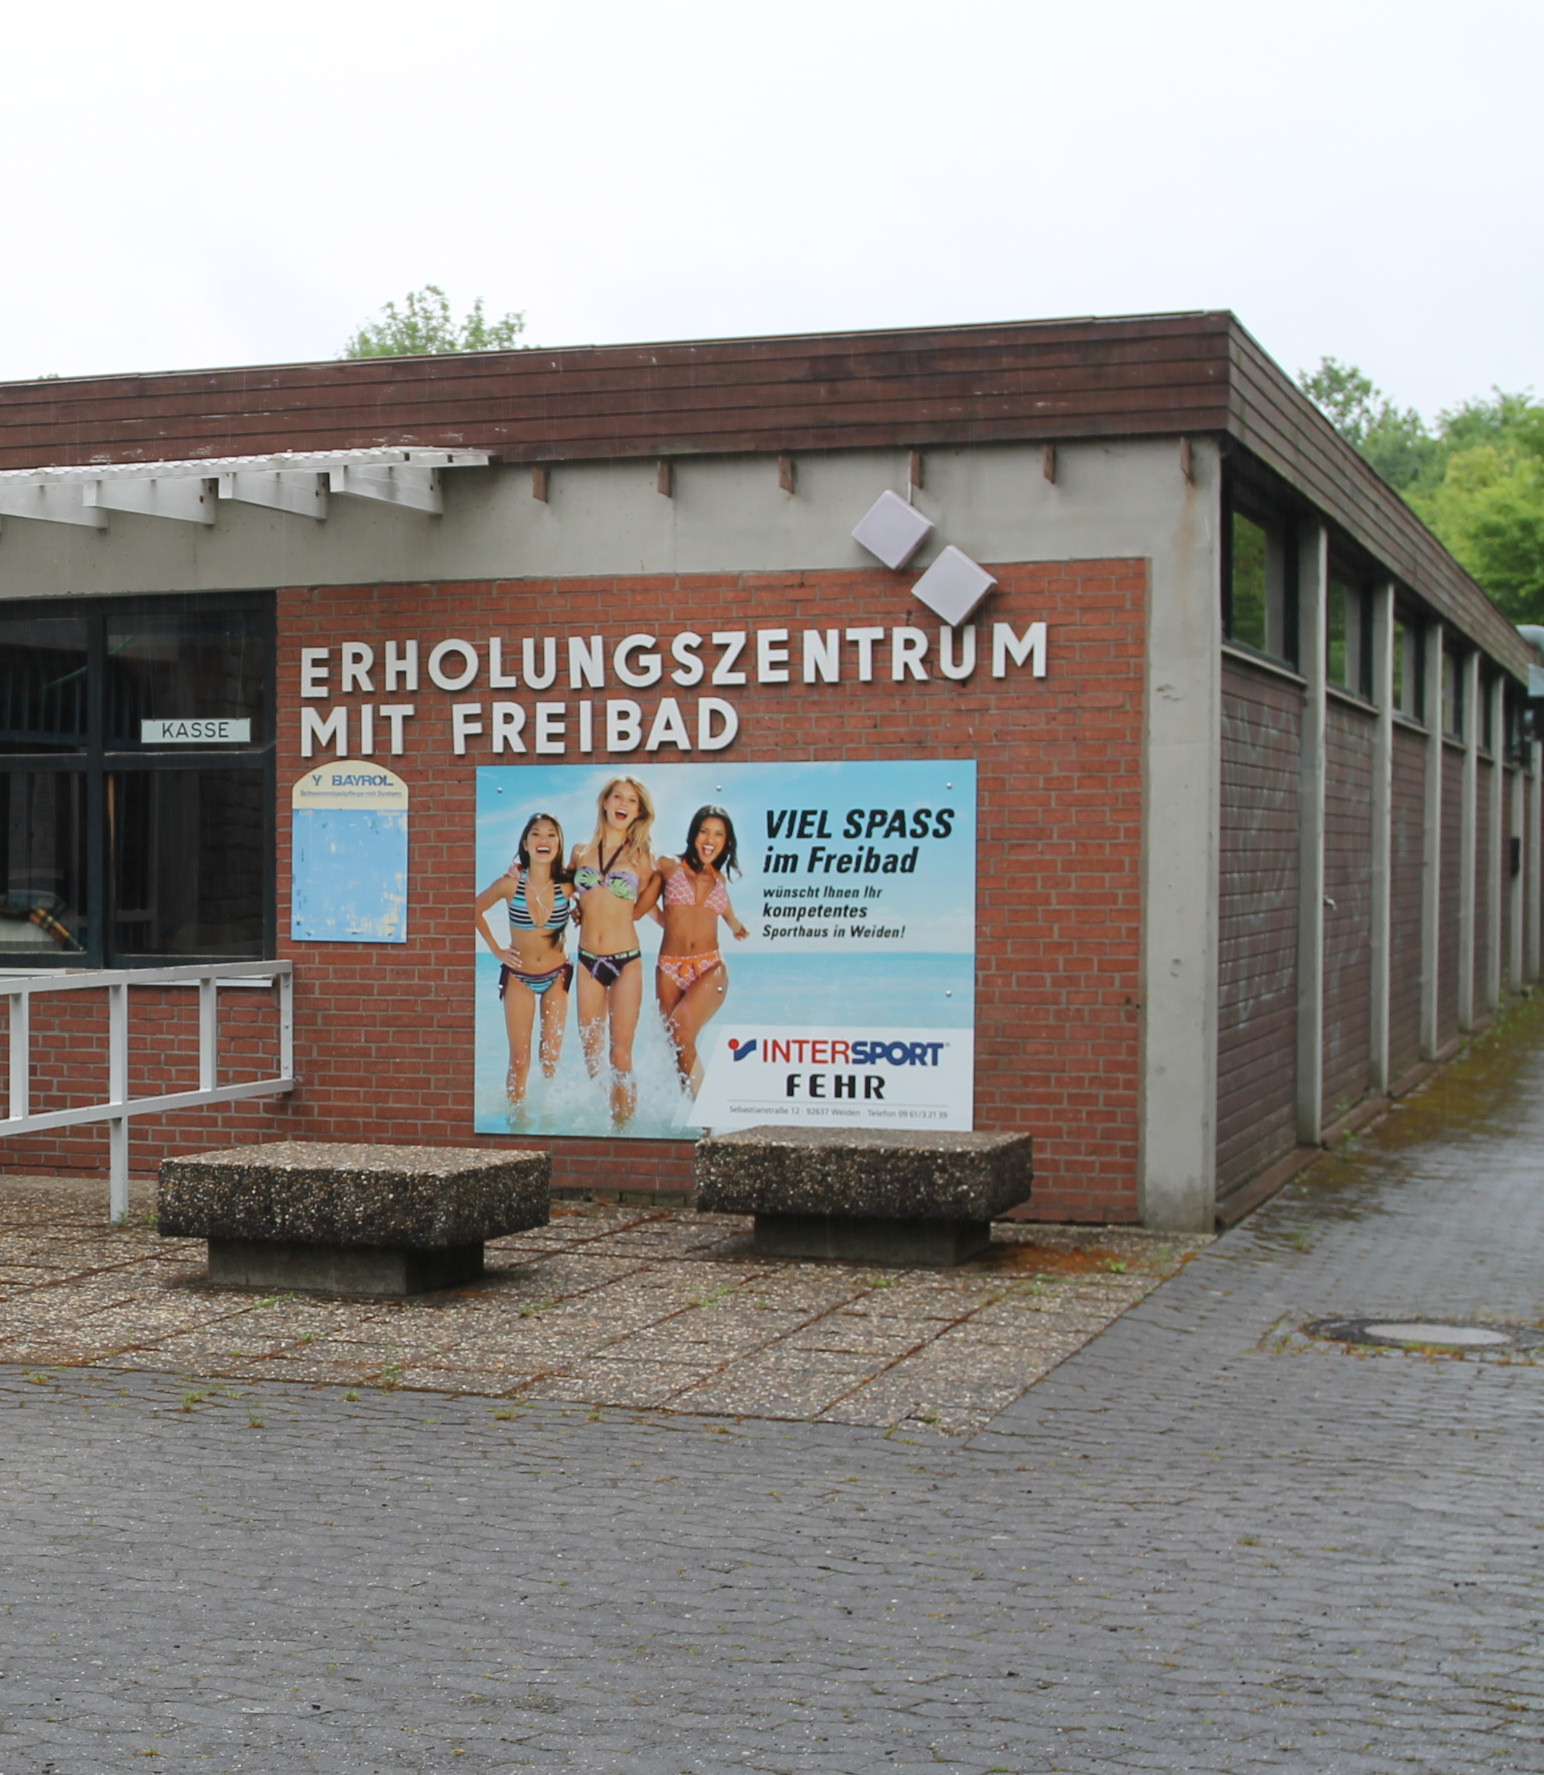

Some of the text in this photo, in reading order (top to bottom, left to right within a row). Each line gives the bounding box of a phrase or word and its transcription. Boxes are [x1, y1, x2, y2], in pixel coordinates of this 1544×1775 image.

[300, 622, 1048, 698] ERHOLUNGSZENTRUM
[161, 721, 230, 739] KASSE
[300, 697, 740, 758] MIT FREIBAD
[331, 774, 394, 787] BAYROL
[766, 808, 955, 839] VIEL SPASS
[762, 846, 920, 874] im Freibad
[762, 885, 883, 899] wünscht Ihnen Ihr
[762, 903, 868, 922] kompetentes
[762, 924, 906, 941] Sporthaus in Weiden!
[762, 1038, 945, 1067] INTERSPORT
[785, 1073, 886, 1100] FEHR
[790, 1106, 801, 1115] 12
[806, 1107, 830, 1117] 92637
[831, 1107, 862, 1117] Weiden
[867, 1109, 897, 1119] Telefon
